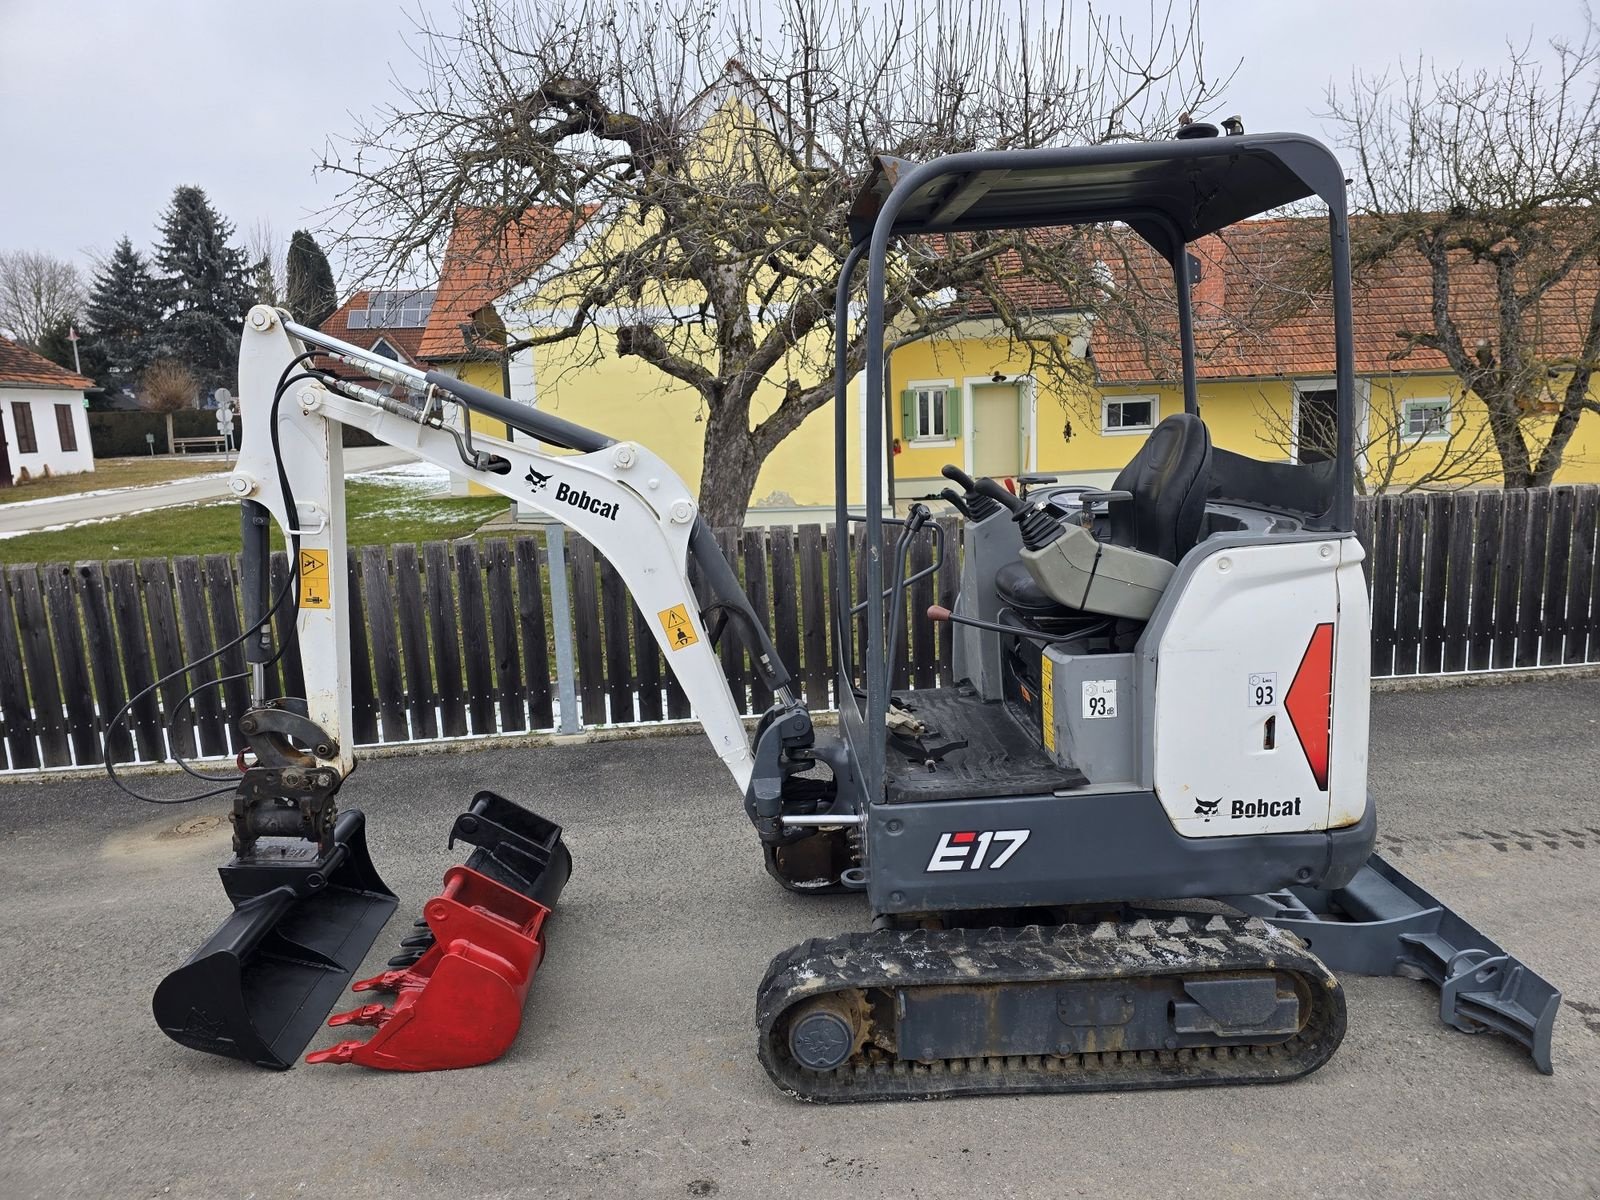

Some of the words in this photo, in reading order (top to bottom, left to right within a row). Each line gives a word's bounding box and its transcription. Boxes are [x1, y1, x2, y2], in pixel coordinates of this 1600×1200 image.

[555, 482, 620, 521] Bobcat
[1089, 697, 1106, 716] 93
[1255, 686, 1274, 706] 93
[1231, 797, 1302, 819] Bobcat
[925, 829, 1031, 872] E17
